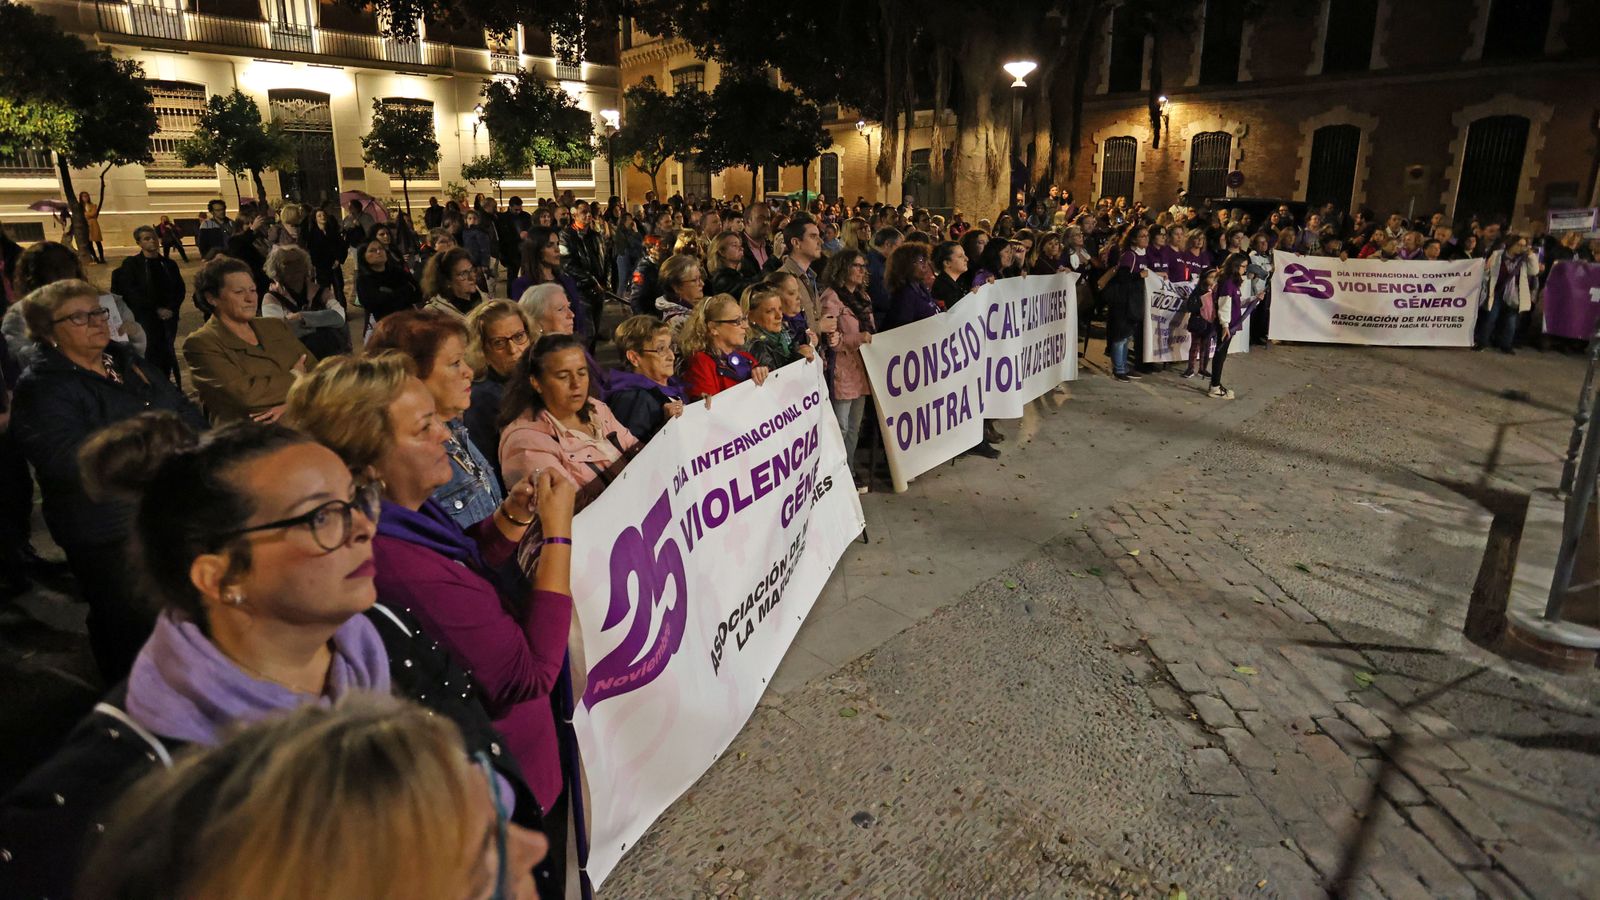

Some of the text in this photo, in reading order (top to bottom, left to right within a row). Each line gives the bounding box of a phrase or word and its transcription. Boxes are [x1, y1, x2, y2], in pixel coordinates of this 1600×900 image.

[1283, 263, 1335, 299] 25
[1338, 281, 1437, 293] VIOLENCIA
[1422, 271, 1461, 279] CONTRA
[1332, 313, 1399, 323] ASOCIACIÓN
[1393, 295, 1467, 308] GÉNERO
[886, 322, 981, 397] CONSEJO
[886, 384, 973, 451] ONTRA
[673, 465, 689, 496] DÍA
[691, 404, 802, 476] INTERNACIONAL
[680, 424, 819, 553] VIOLENCIA
[582, 488, 688, 710] 25
[711, 554, 788, 677] ASOCIACIÓN
[736, 618, 755, 652] LA
